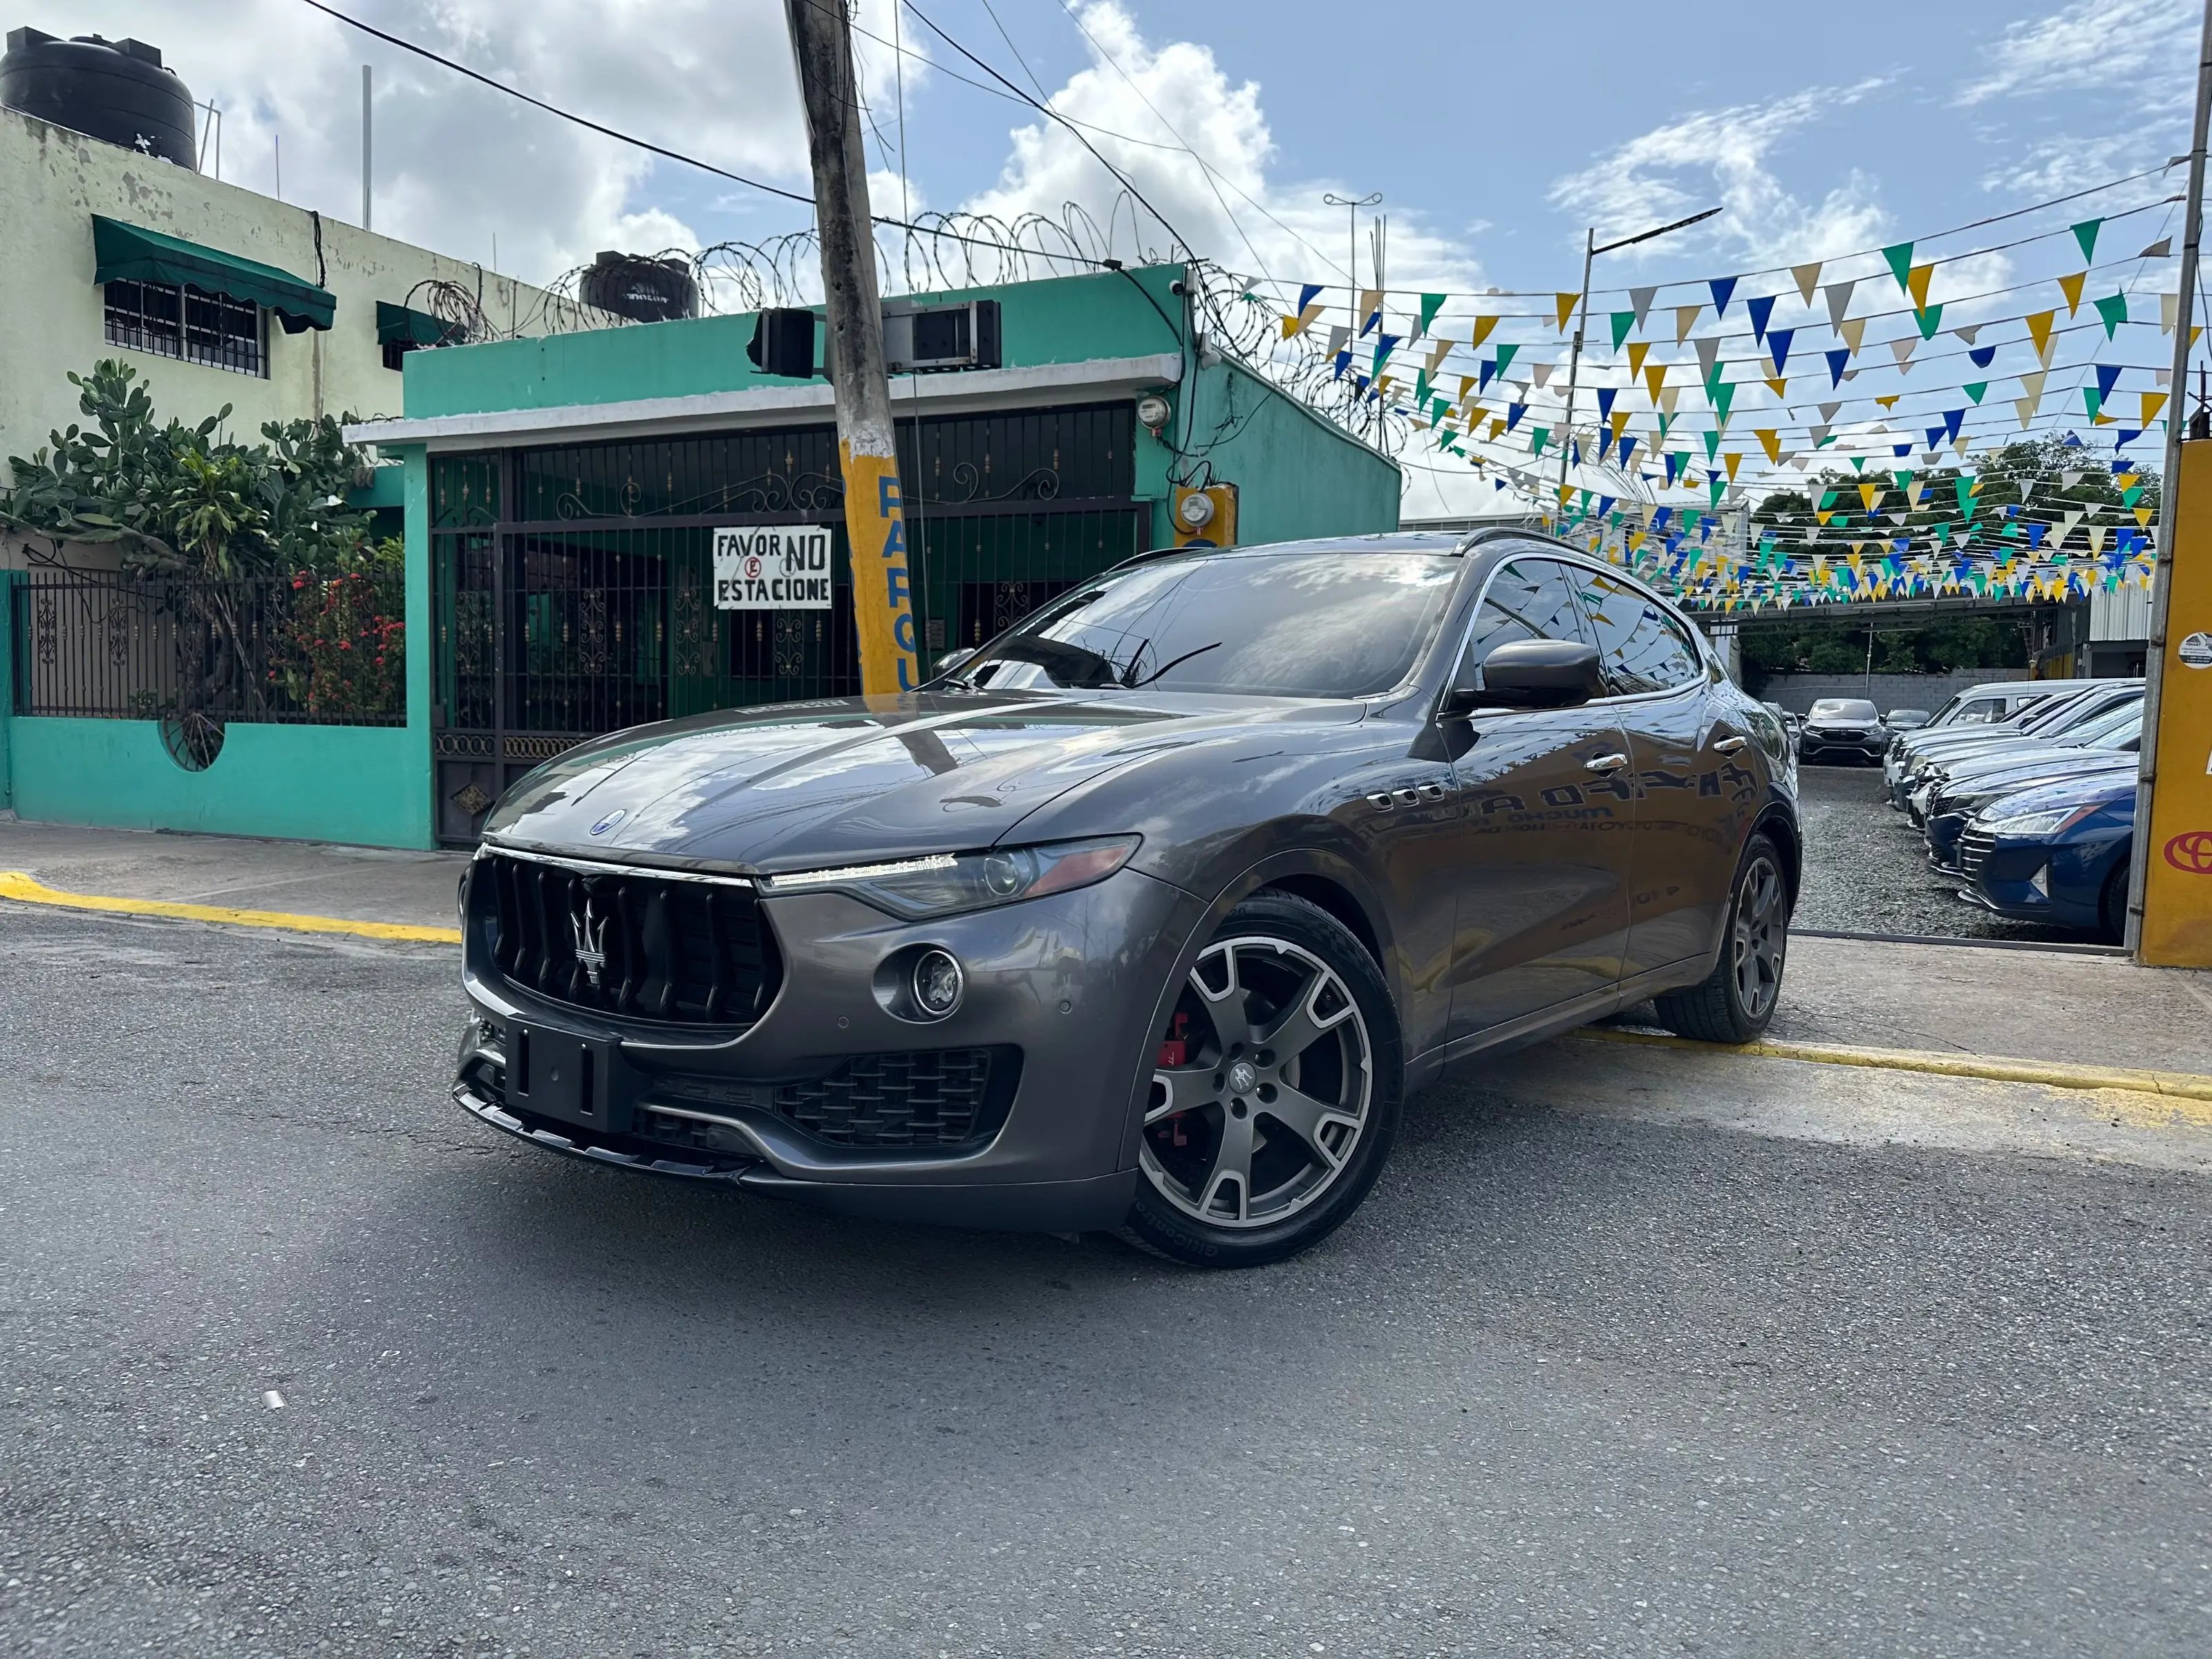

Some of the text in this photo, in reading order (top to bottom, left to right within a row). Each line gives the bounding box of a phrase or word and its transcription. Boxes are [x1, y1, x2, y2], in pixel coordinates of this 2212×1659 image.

[718, 534, 825, 572] FAVOR NO
[718, 579, 829, 601] ESTACIONE
